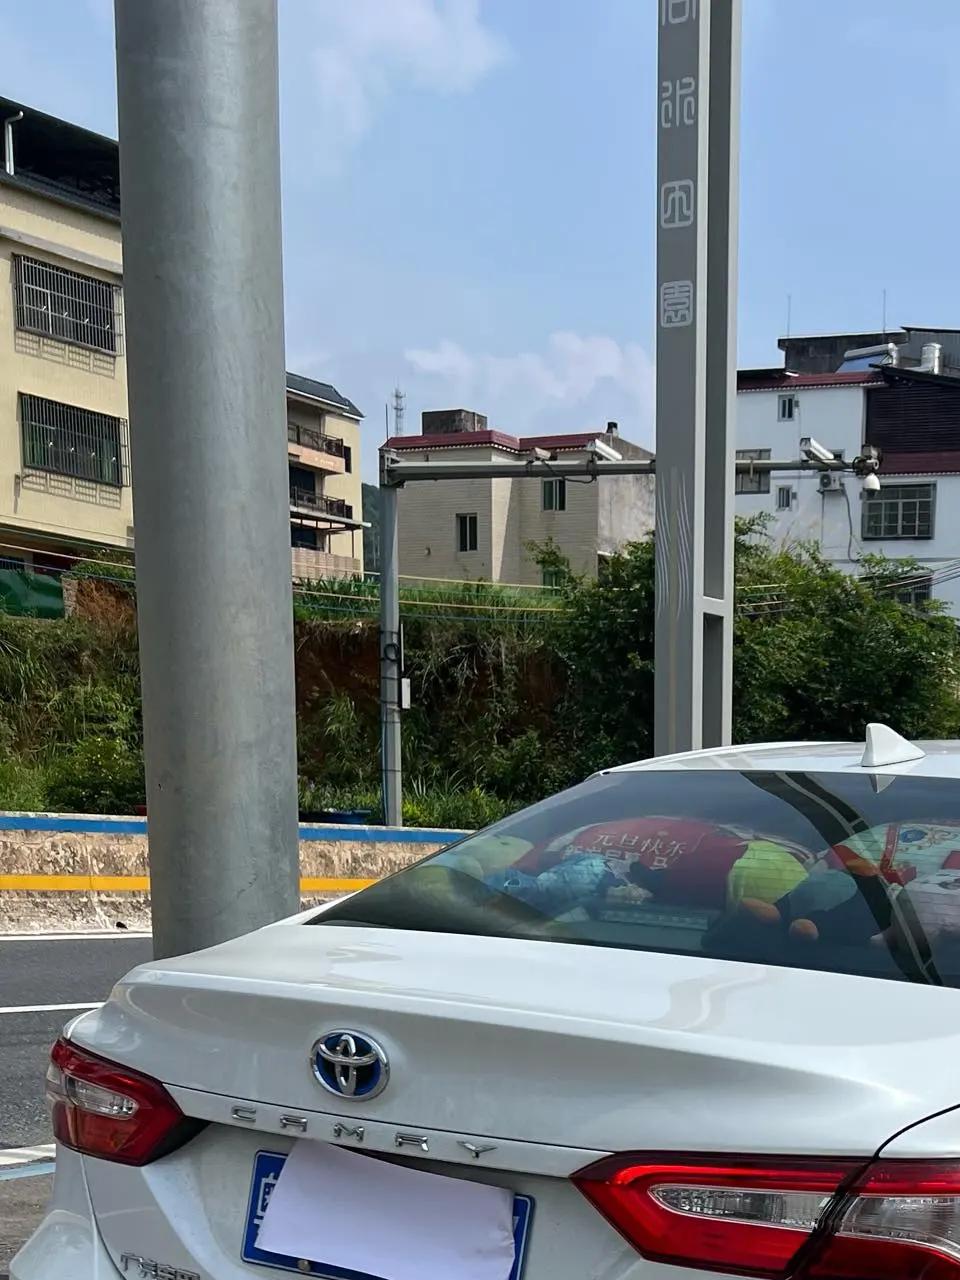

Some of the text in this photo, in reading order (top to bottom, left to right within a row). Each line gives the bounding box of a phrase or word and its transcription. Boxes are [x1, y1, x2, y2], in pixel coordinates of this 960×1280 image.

[592, 831, 689, 857] 元旦快乐
[231, 1105, 498, 1160] CAMRY
